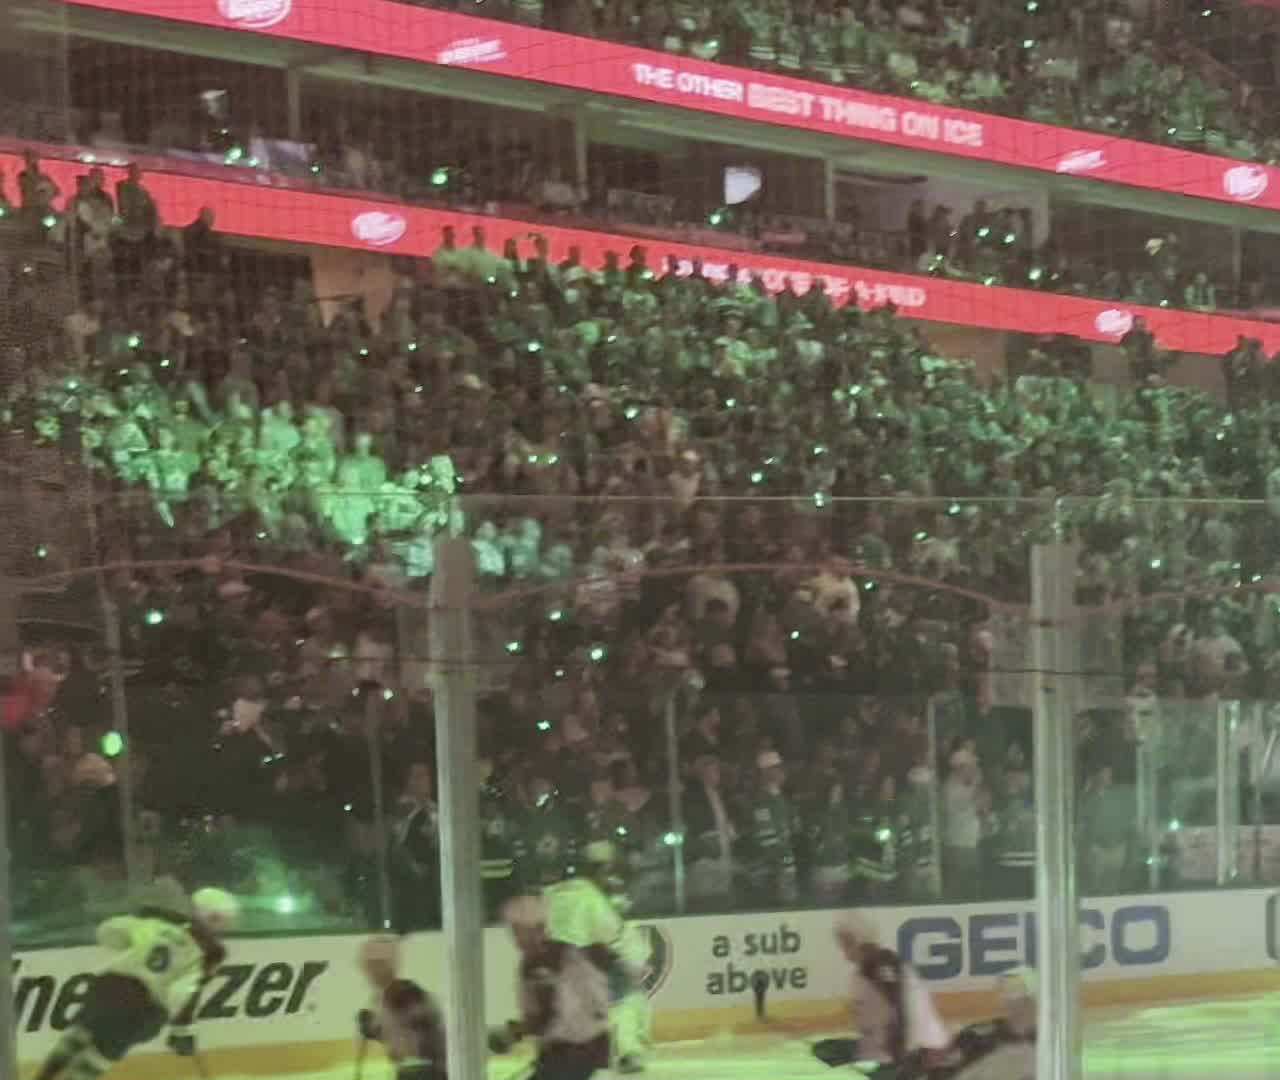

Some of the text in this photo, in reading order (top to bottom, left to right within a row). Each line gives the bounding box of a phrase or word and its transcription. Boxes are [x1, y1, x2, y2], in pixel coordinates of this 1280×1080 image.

[632, 63, 983, 147] THE OTHER BEST THING ON ICE
[711, 923, 801, 958] a sub
[705, 961, 808, 995] above
